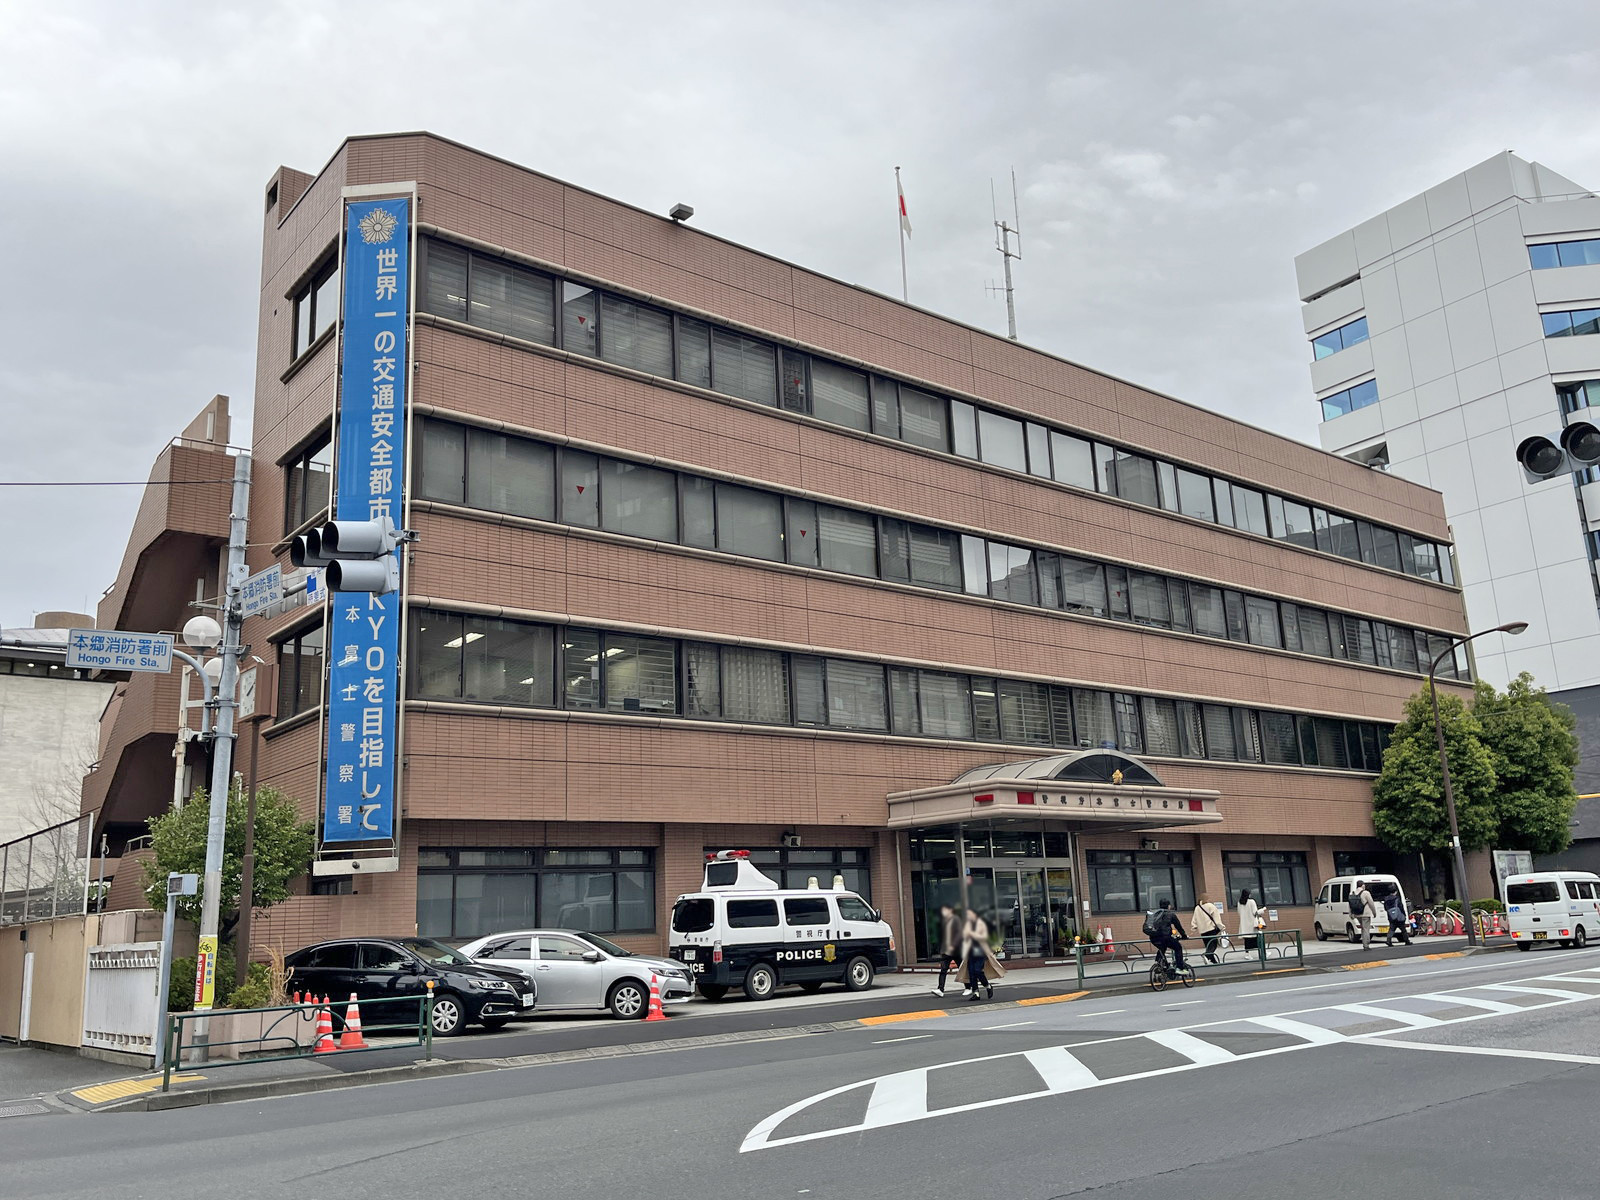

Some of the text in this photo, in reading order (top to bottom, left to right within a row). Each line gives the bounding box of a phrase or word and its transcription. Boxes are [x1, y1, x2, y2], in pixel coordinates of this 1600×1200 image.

[245, 600, 260, 610] Hongo
[73, 634, 168, 656] 本郷消防署前
[78, 653, 160, 667] Hongo Fire Sta.
[338, 606, 360, 825] 本富士警察署
[776, 949, 822, 961] POLICE
